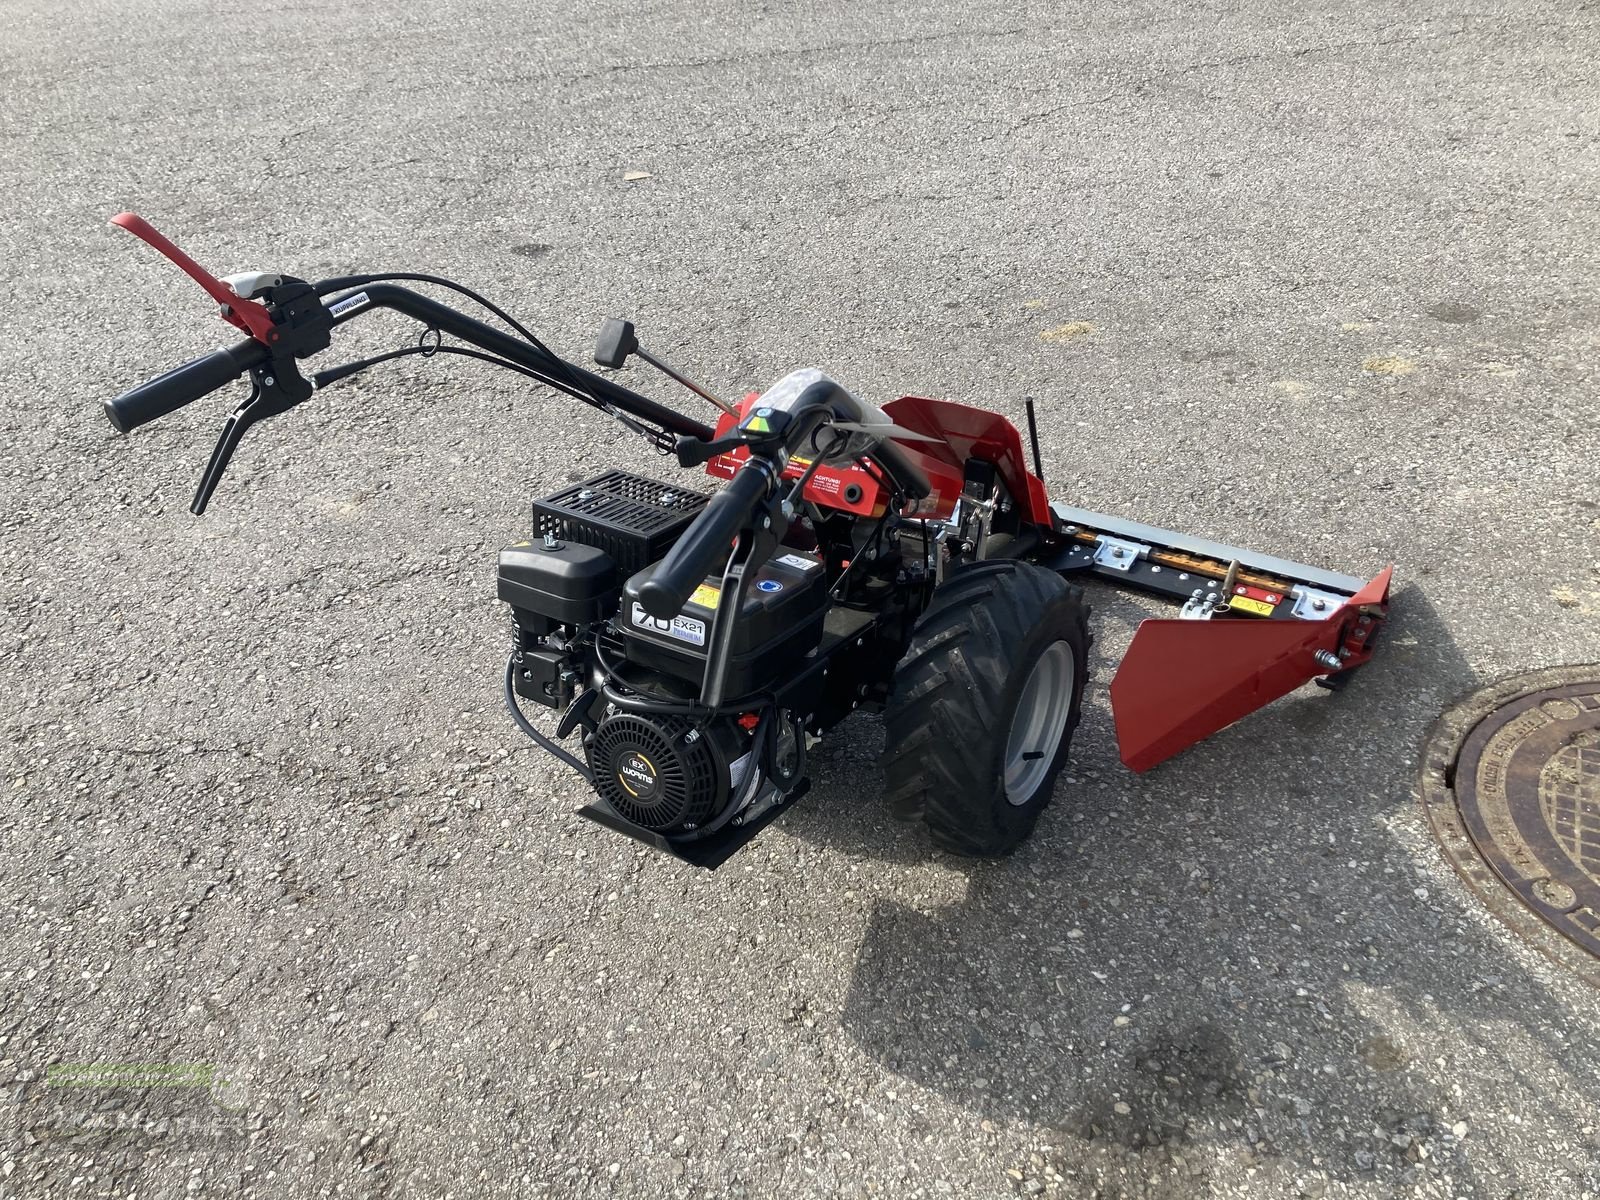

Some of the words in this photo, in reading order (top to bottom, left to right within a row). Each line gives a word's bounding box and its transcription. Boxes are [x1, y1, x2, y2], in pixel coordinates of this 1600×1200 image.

[334, 296, 367, 314] KUPPLUNG
[815, 474, 841, 485] ACHTUNG!
[673, 618, 703, 634] EX21
[632, 760, 645, 771] EX
